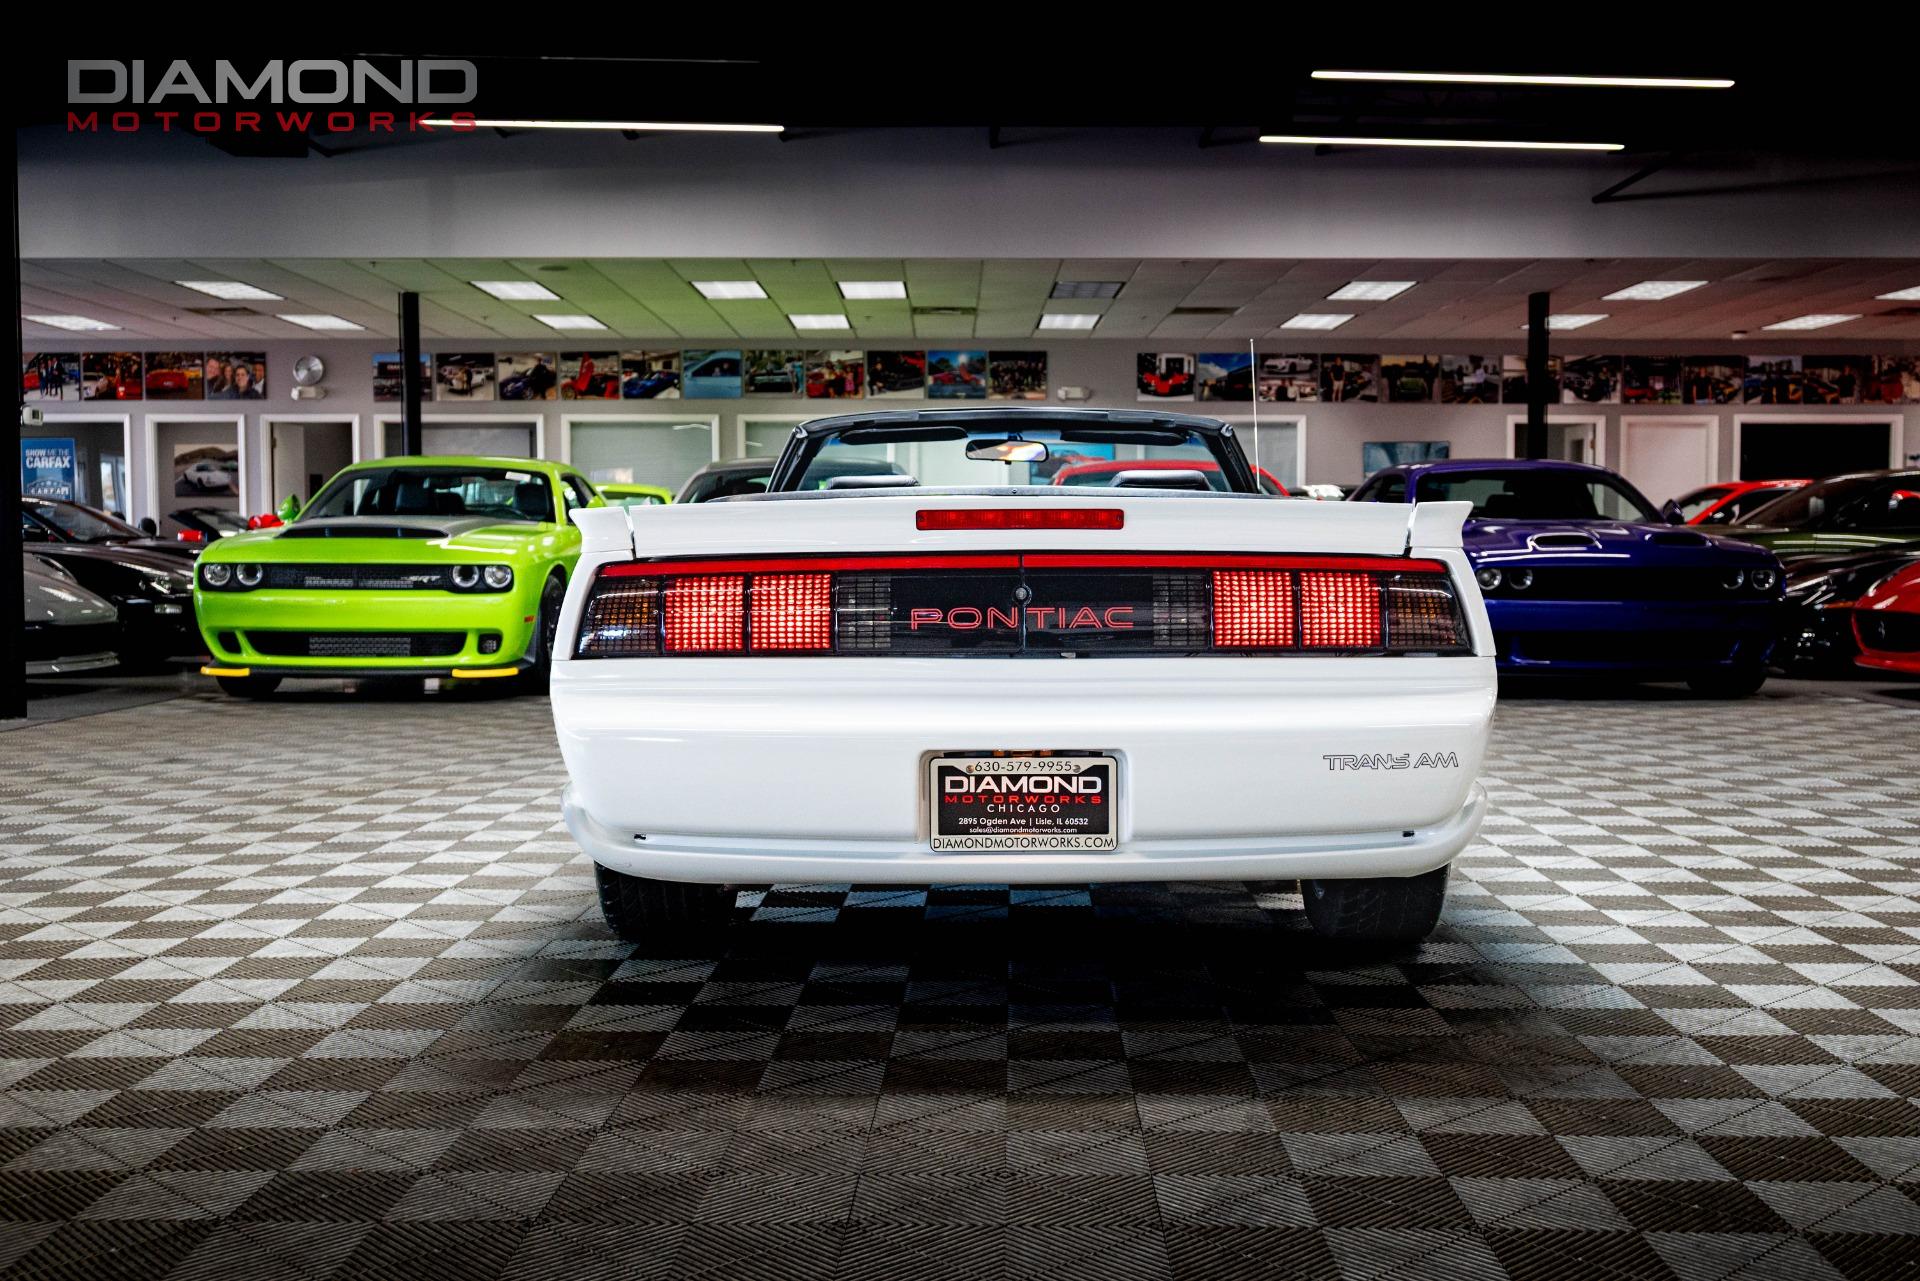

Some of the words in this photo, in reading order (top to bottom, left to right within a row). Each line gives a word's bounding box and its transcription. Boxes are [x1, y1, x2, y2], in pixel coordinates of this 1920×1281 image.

[25, 449, 46, 457] SHOW
[26, 456, 70, 468] CARFAX
[910, 606, 1134, 630] PONTIAC
[974, 761, 1072, 772] 630-579-9955
[1322, 753, 1410, 771] TRANS
[1413, 751, 1459, 769] AM
[945, 776, 1101, 793] DIAMOND
[945, 796, 1102, 804] MOTORWORKS
[987, 804, 1060, 813] CHICAGO
[979, 818, 1008, 827] Ogden
[1035, 818, 1054, 826] Lisle,
[933, 837, 1115, 849] DIAMONDMOTORWORKS.COM
